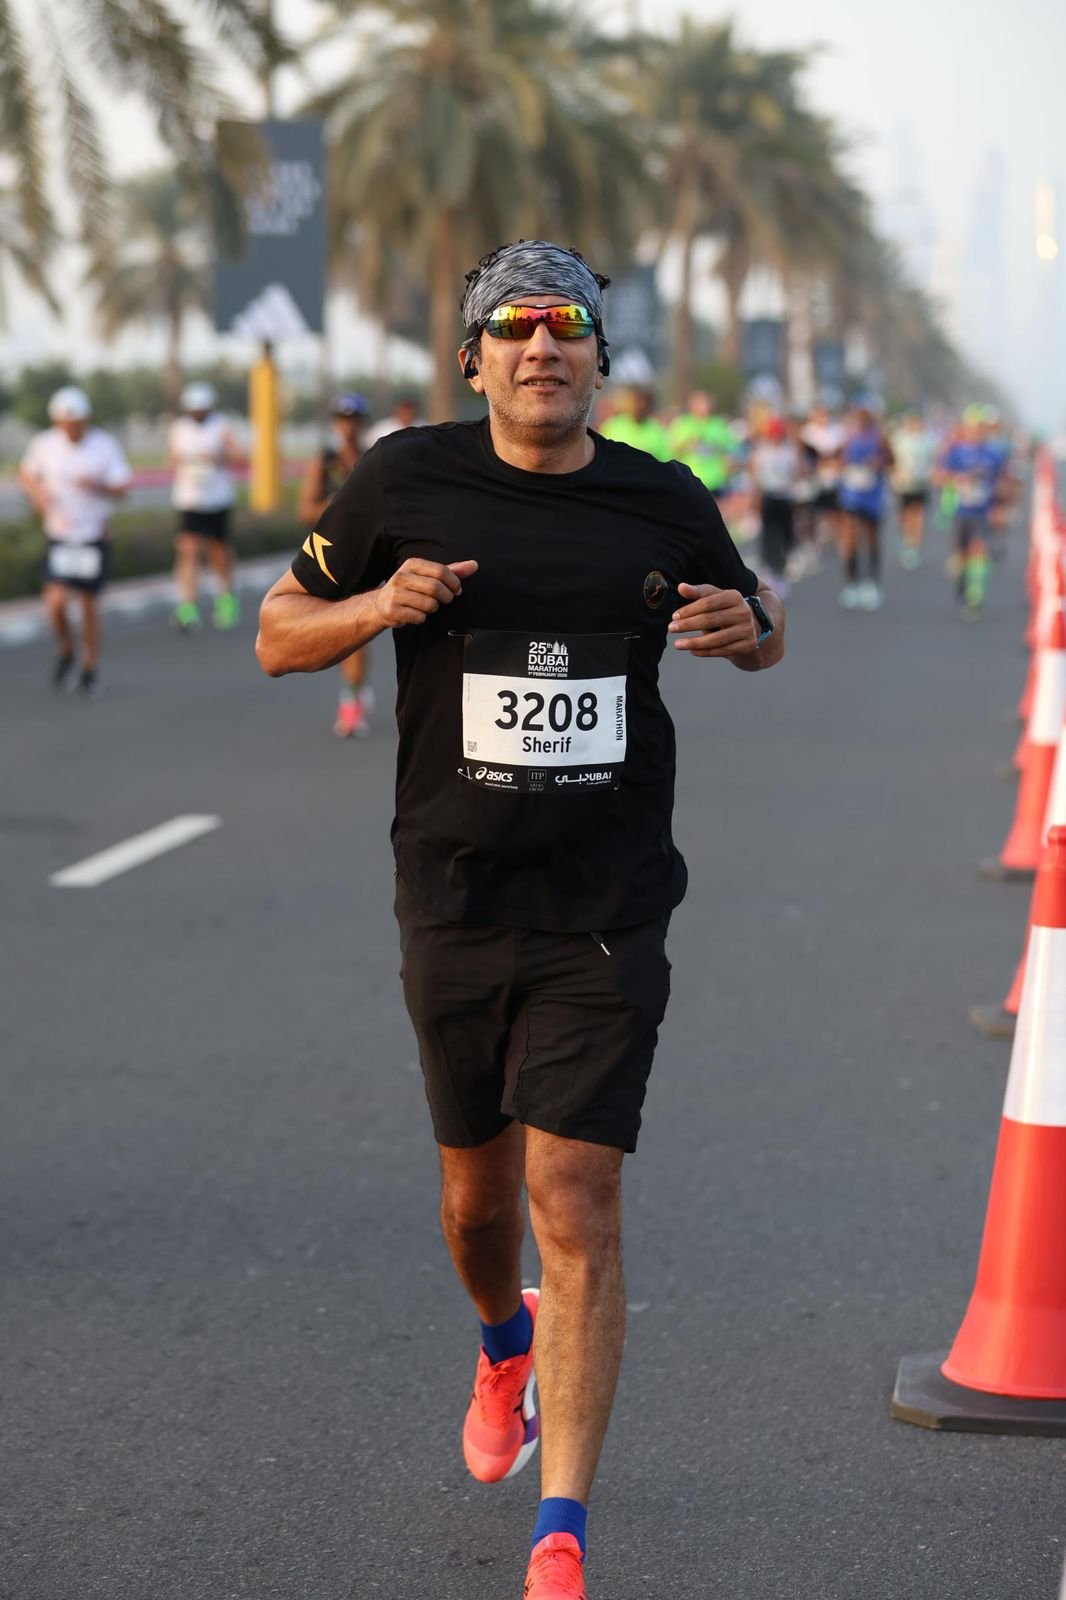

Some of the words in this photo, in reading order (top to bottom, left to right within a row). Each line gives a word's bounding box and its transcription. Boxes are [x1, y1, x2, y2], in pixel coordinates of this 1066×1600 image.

[529, 641, 553, 654] 25th
[528, 654, 569, 666] DUBAI
[528, 665, 568, 673] MARATHON
[494, 690, 599, 732] 3208
[615, 695, 624, 741] MARATHON
[522, 736, 572, 753] Sherif
[531, 771, 545, 780] ITP
